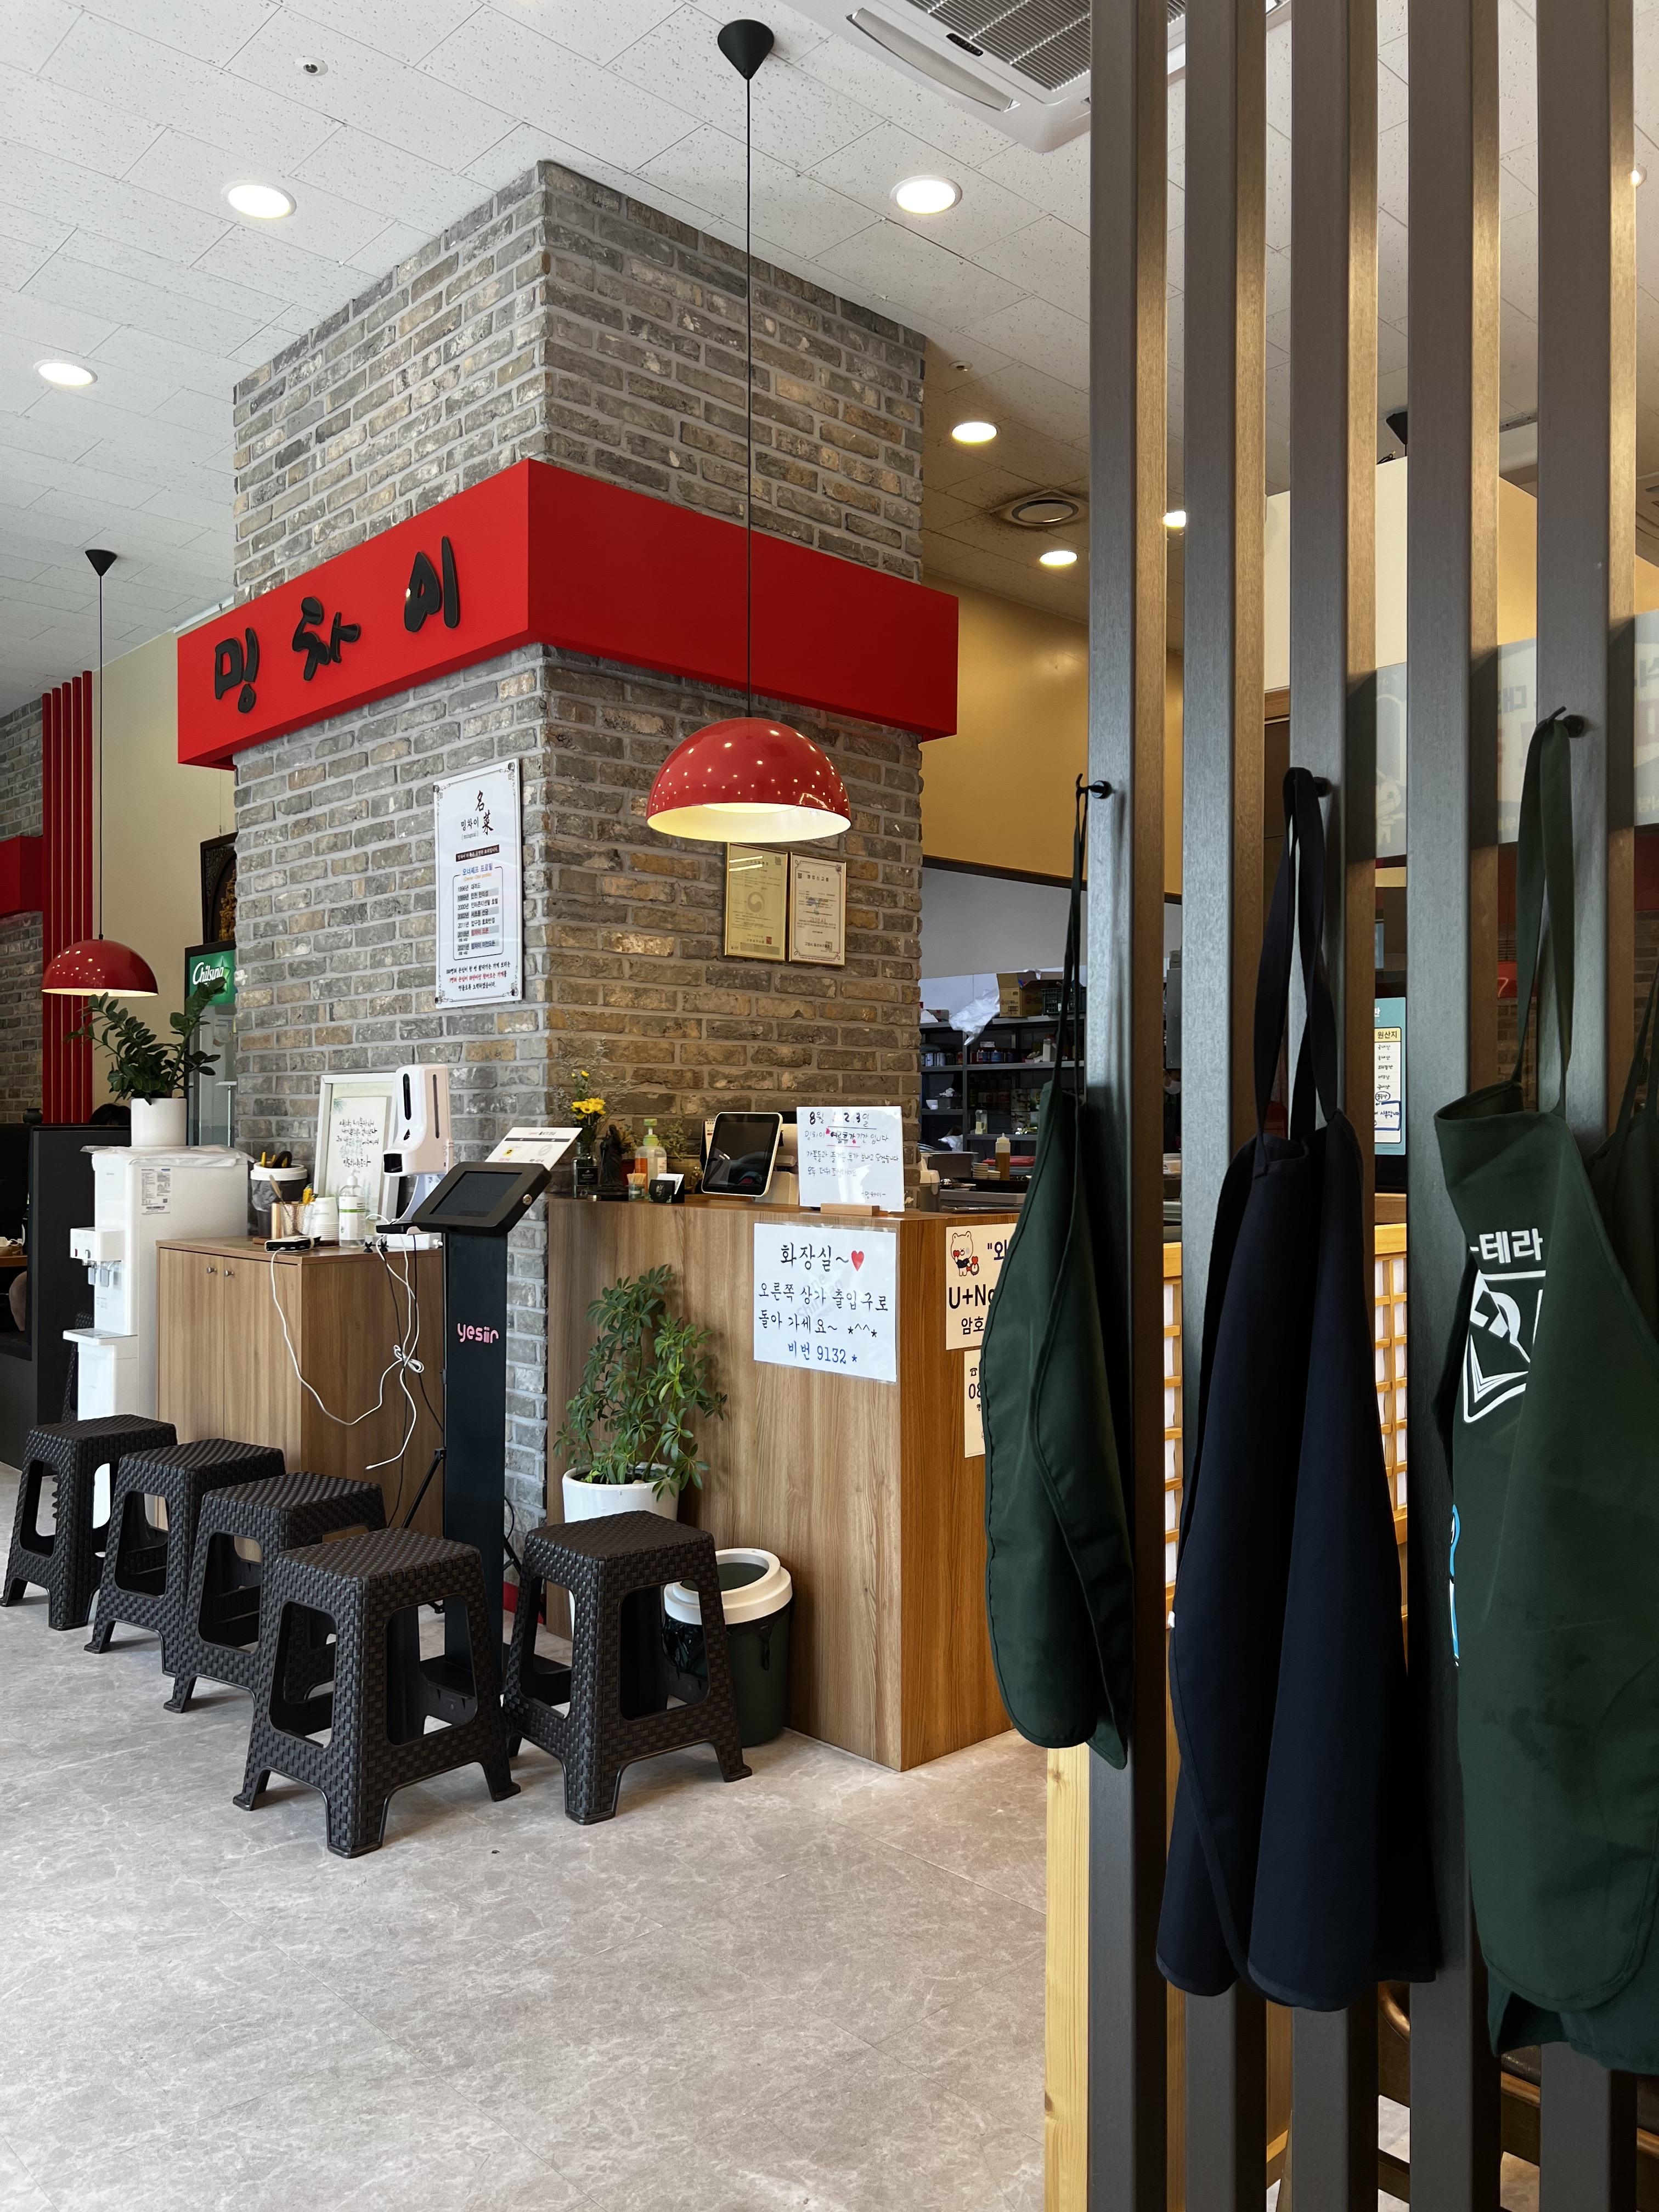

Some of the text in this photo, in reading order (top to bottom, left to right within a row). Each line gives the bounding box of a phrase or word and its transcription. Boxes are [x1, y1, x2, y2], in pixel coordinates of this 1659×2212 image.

[215, 535, 460, 713] 밍차이
[461, 816, 479, 831] 밍차이
[1378, 1031, 1397, 1039] 원산지
[810, 1111, 825, 1125] 8월
[848, 1153, 859, 1163] 휴가
[758, 1282, 794, 1302] 오른쪽
[800, 1285, 826, 1306] 상가
[758, 1310, 783, 1329] 돌아
[961, 1316, 985, 1335] 암호
[787, 1340, 847, 1364] 비번 9132
